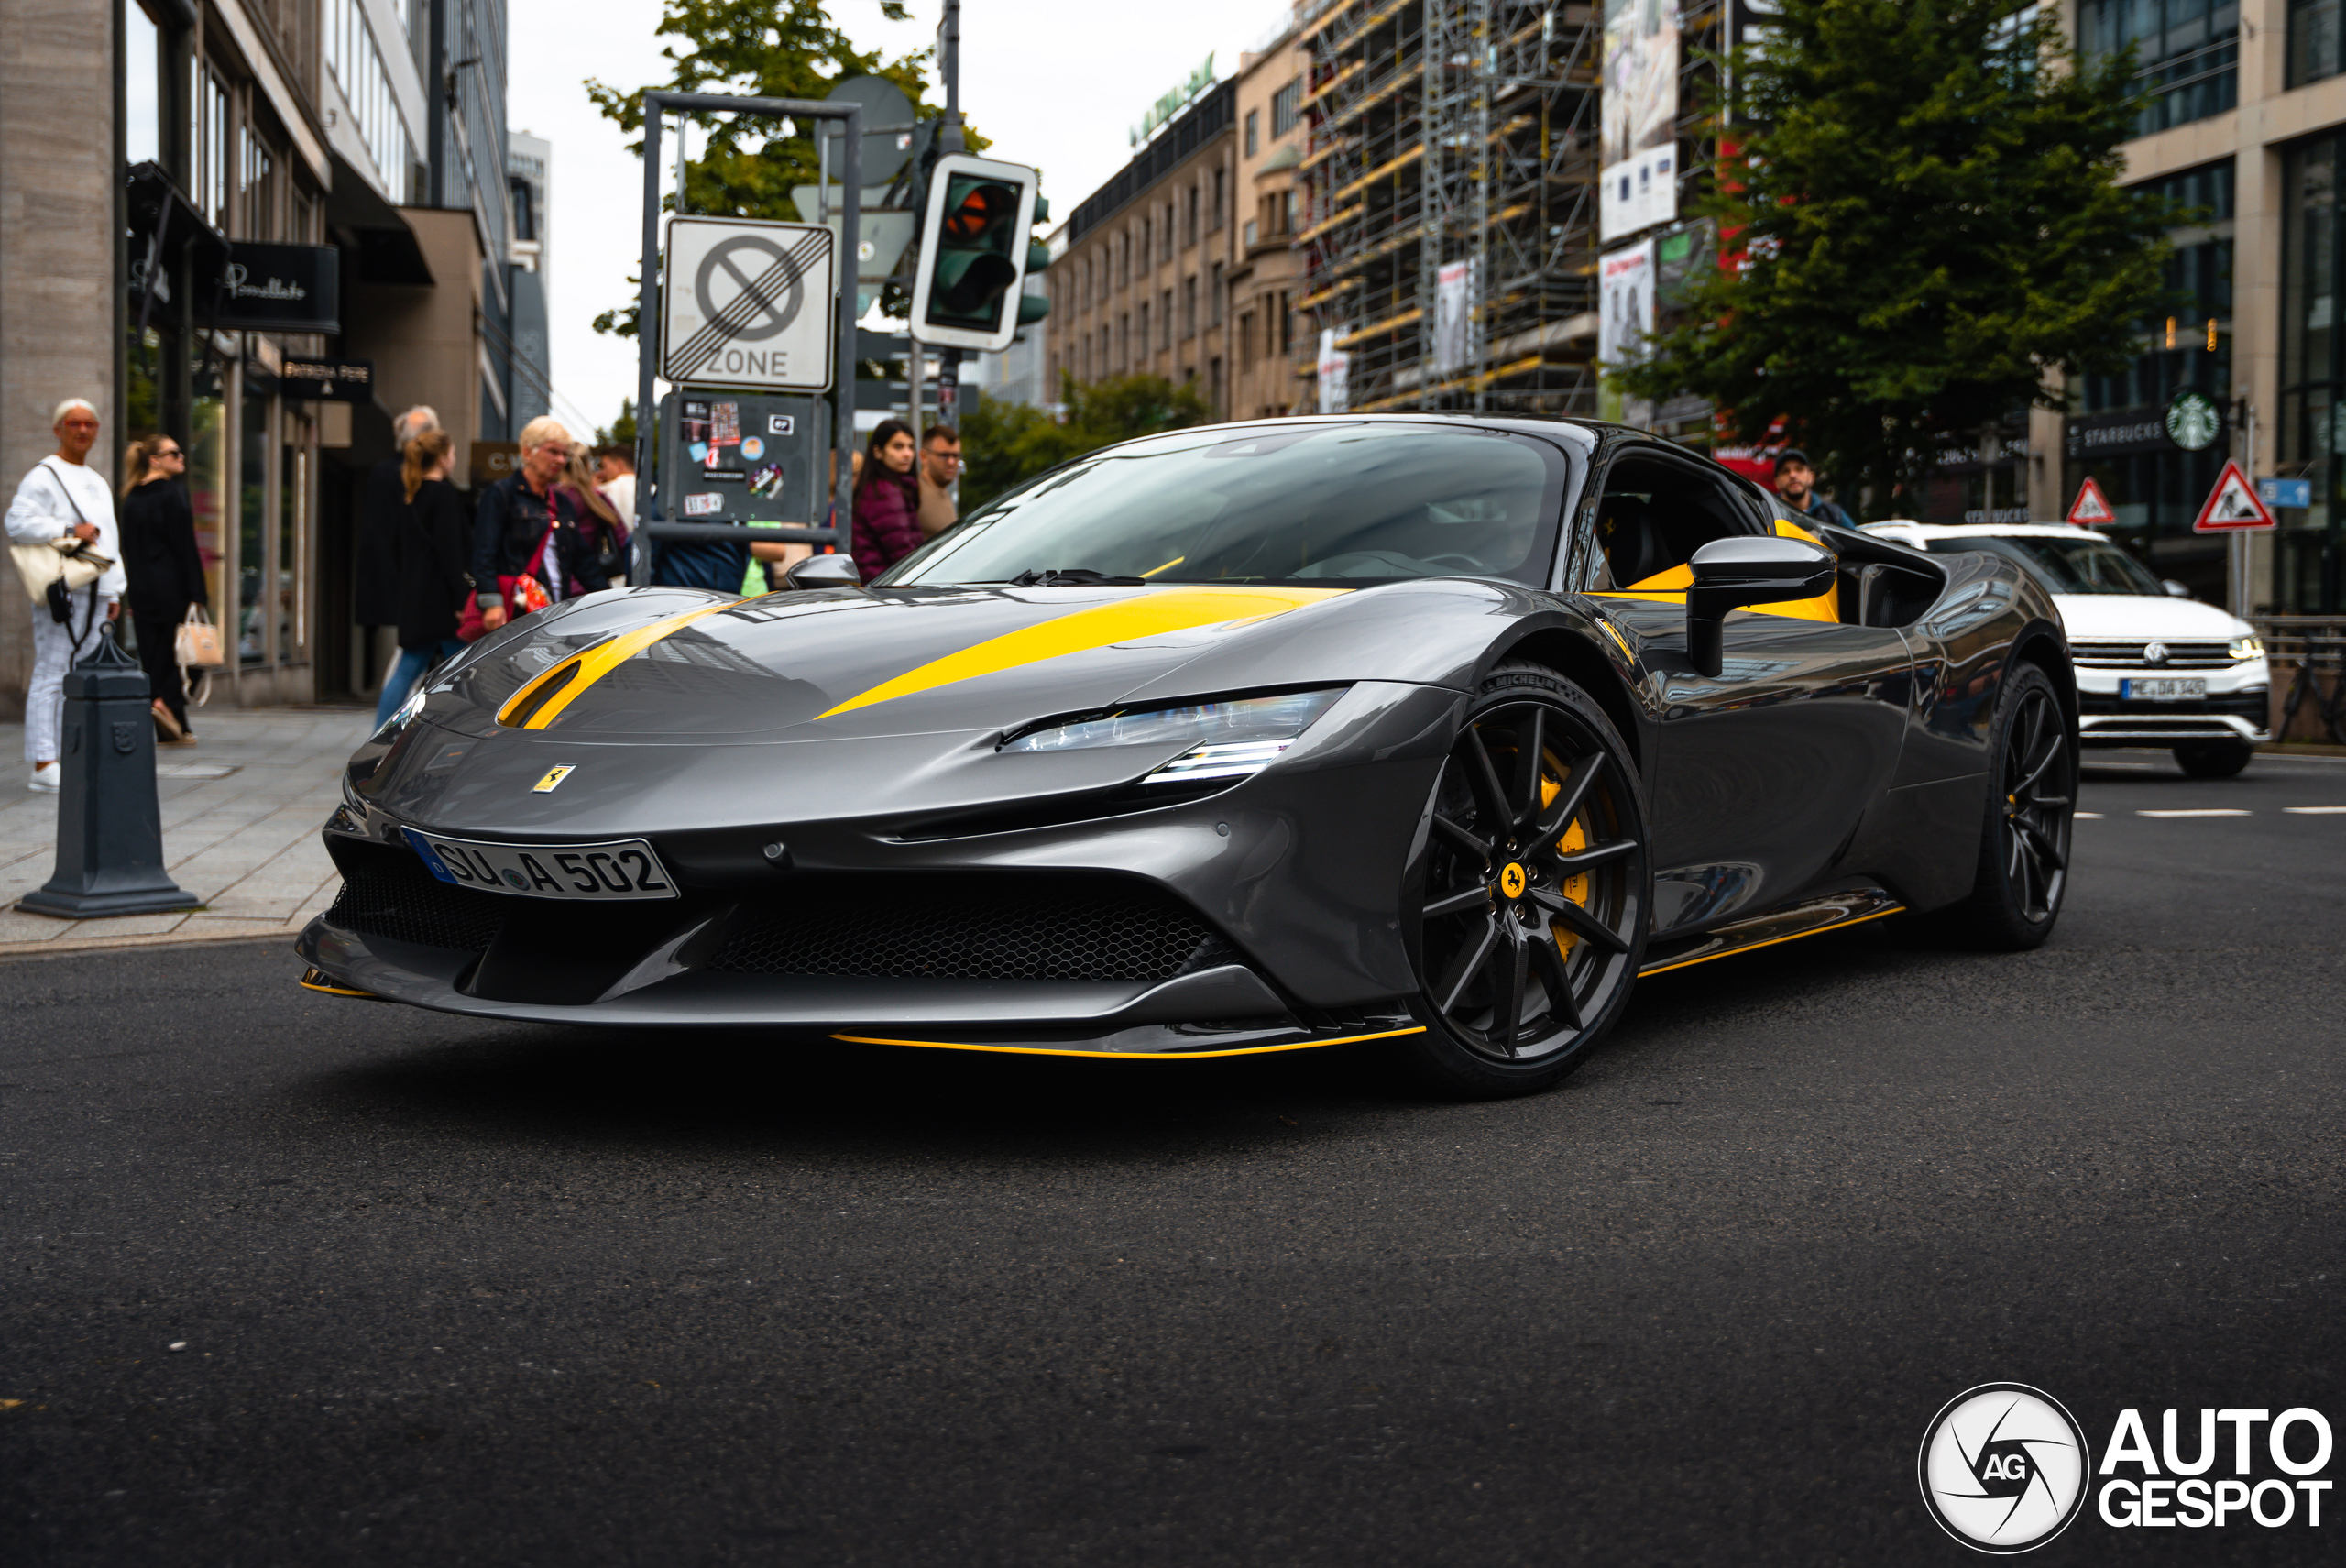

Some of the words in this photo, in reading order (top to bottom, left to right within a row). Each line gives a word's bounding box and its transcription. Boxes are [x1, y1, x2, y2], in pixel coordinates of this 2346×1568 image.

[224, 262, 306, 300] Pomellato
[284, 361, 337, 381] PATRIZIA
[339, 364, 369, 383] PEPE
[707, 348, 788, 377] ZONE
[2084, 421, 2164, 448] STARBUCKS
[1964, 506, 2029, 523] STABUCKS
[1496, 674, 1556, 689] MICHELIN
[2130, 683, 2148, 696] ME
[433, 843, 505, 887] SU
[518, 852, 565, 892] A
[554, 848, 669, 893] 502
